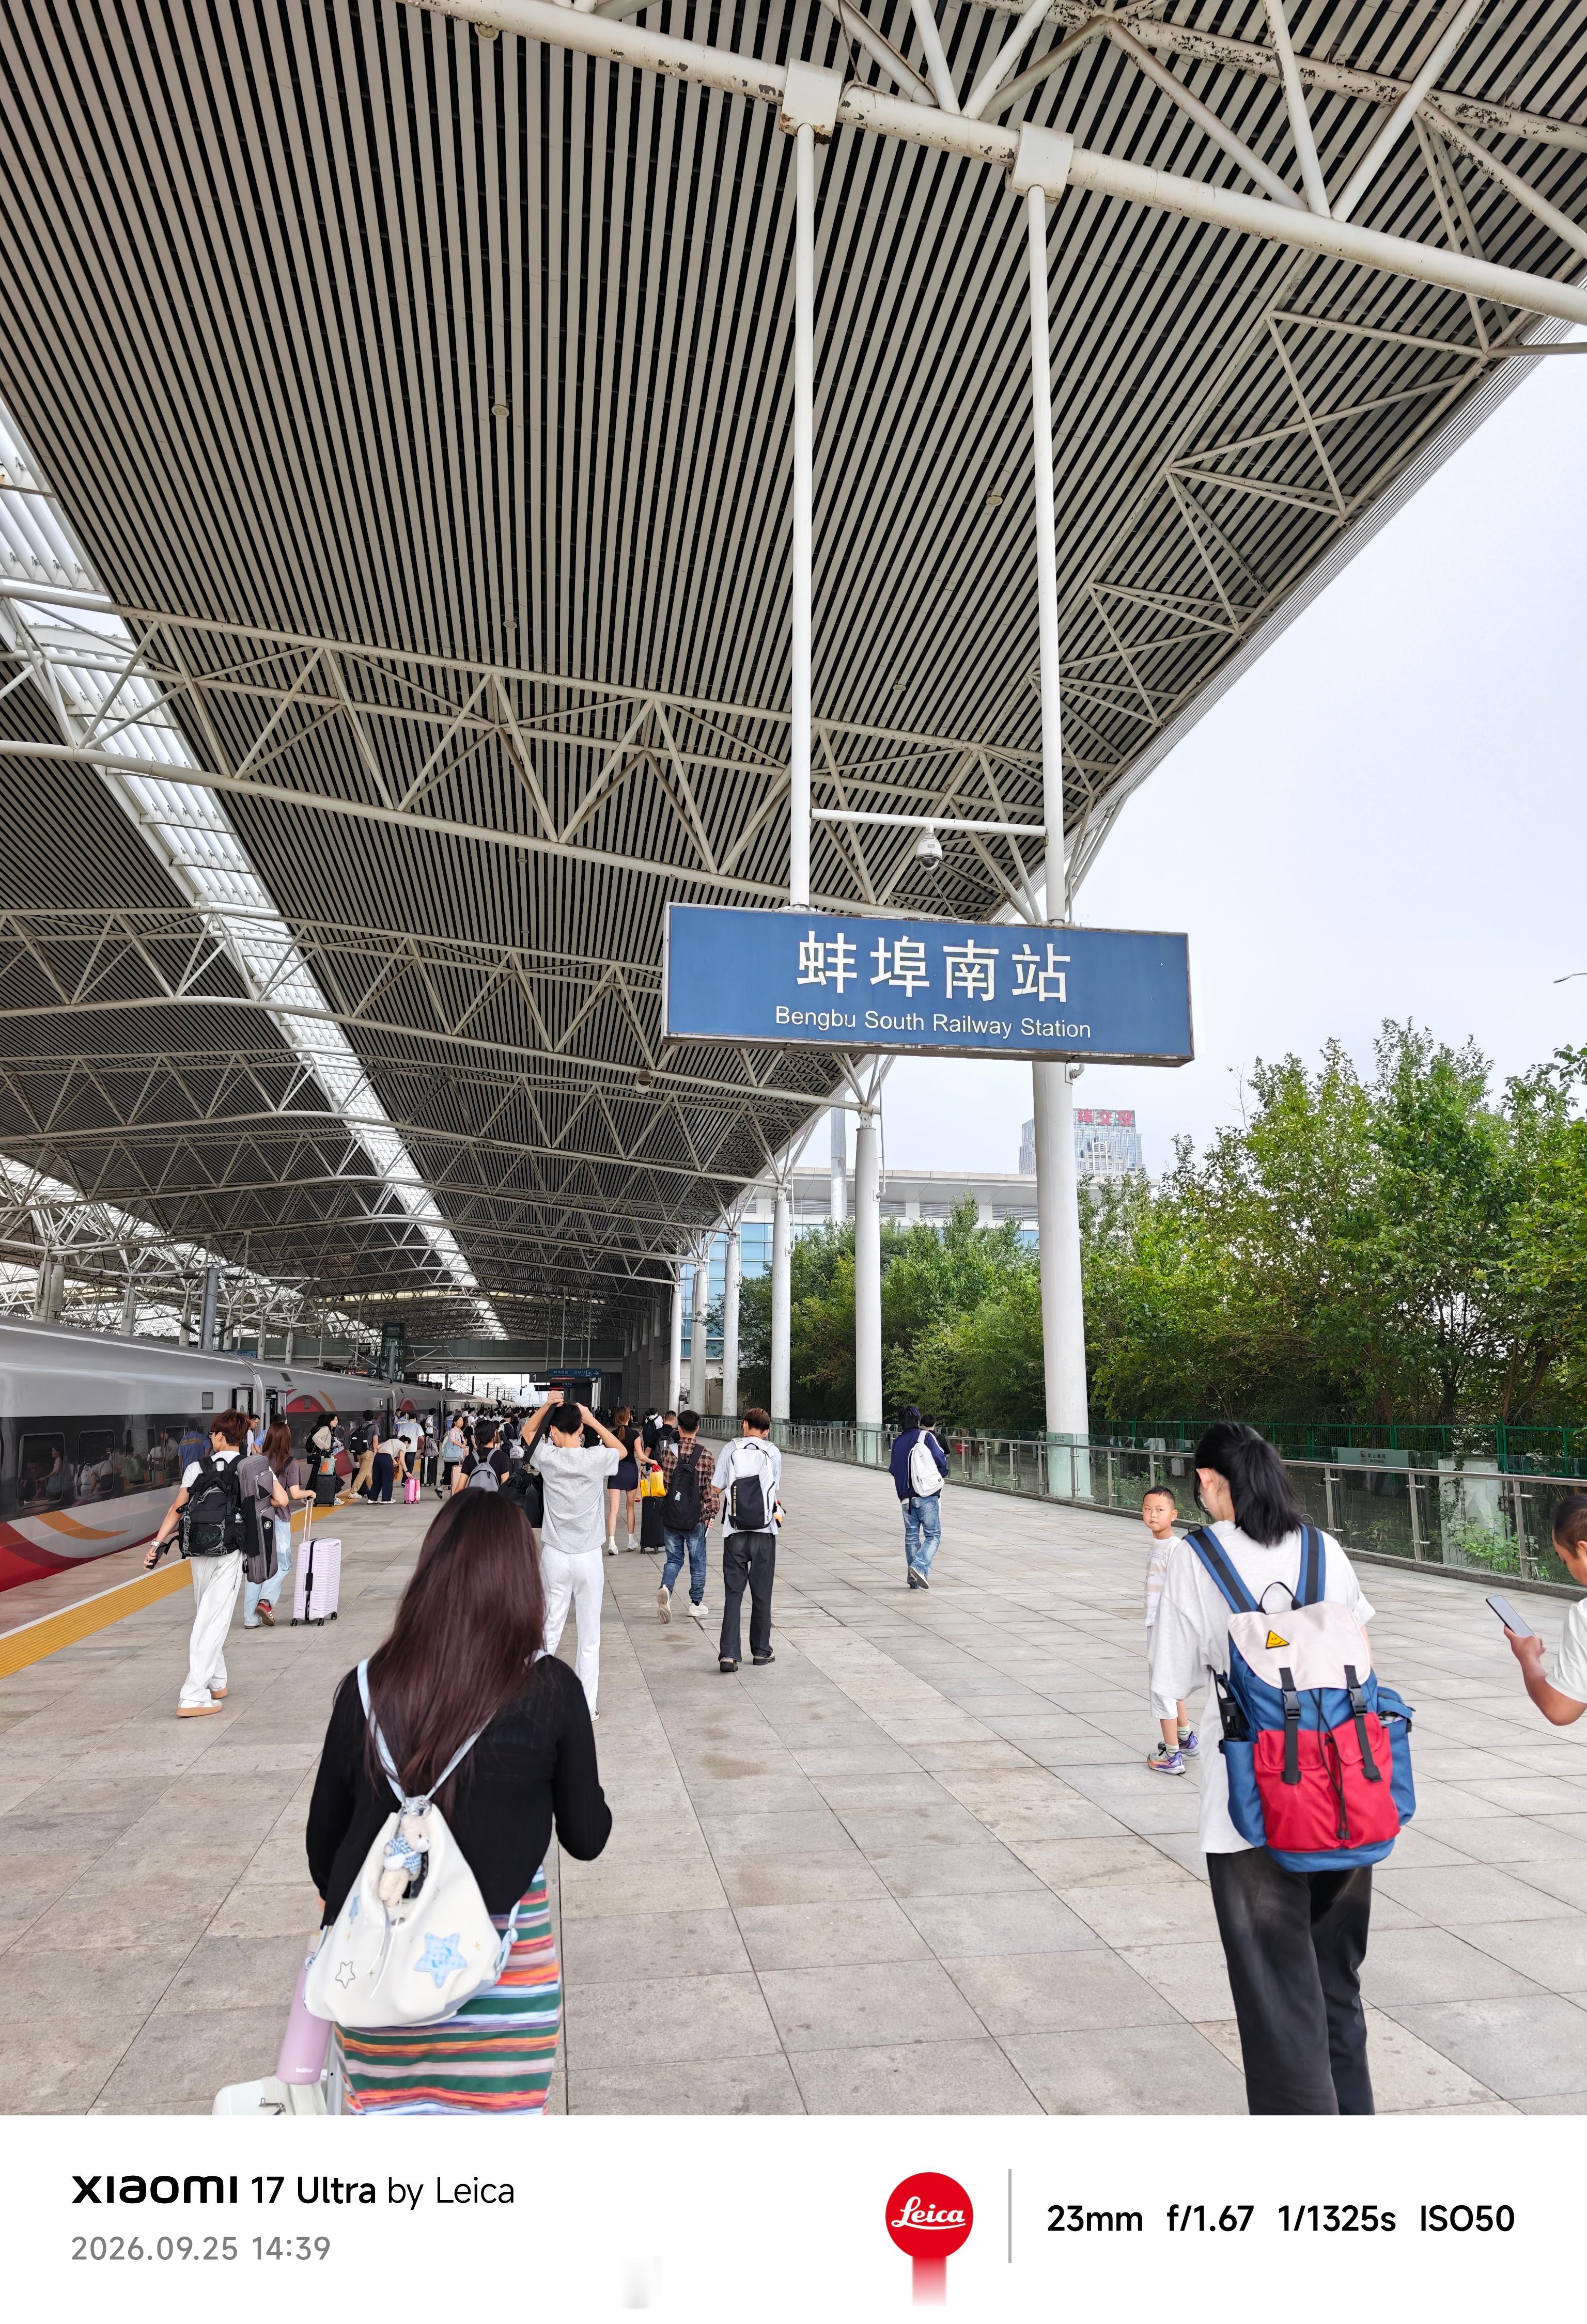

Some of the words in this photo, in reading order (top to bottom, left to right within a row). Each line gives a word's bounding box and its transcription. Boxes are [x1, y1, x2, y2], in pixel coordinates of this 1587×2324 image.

[796, 930, 1071, 1003] 蚌埠南站
[775, 1005, 856, 1031] Bengbu
[864, 1010, 925, 1031] South
[933, 1013, 1012, 1040] Railway
[1020, 1017, 1091, 1039] Station
